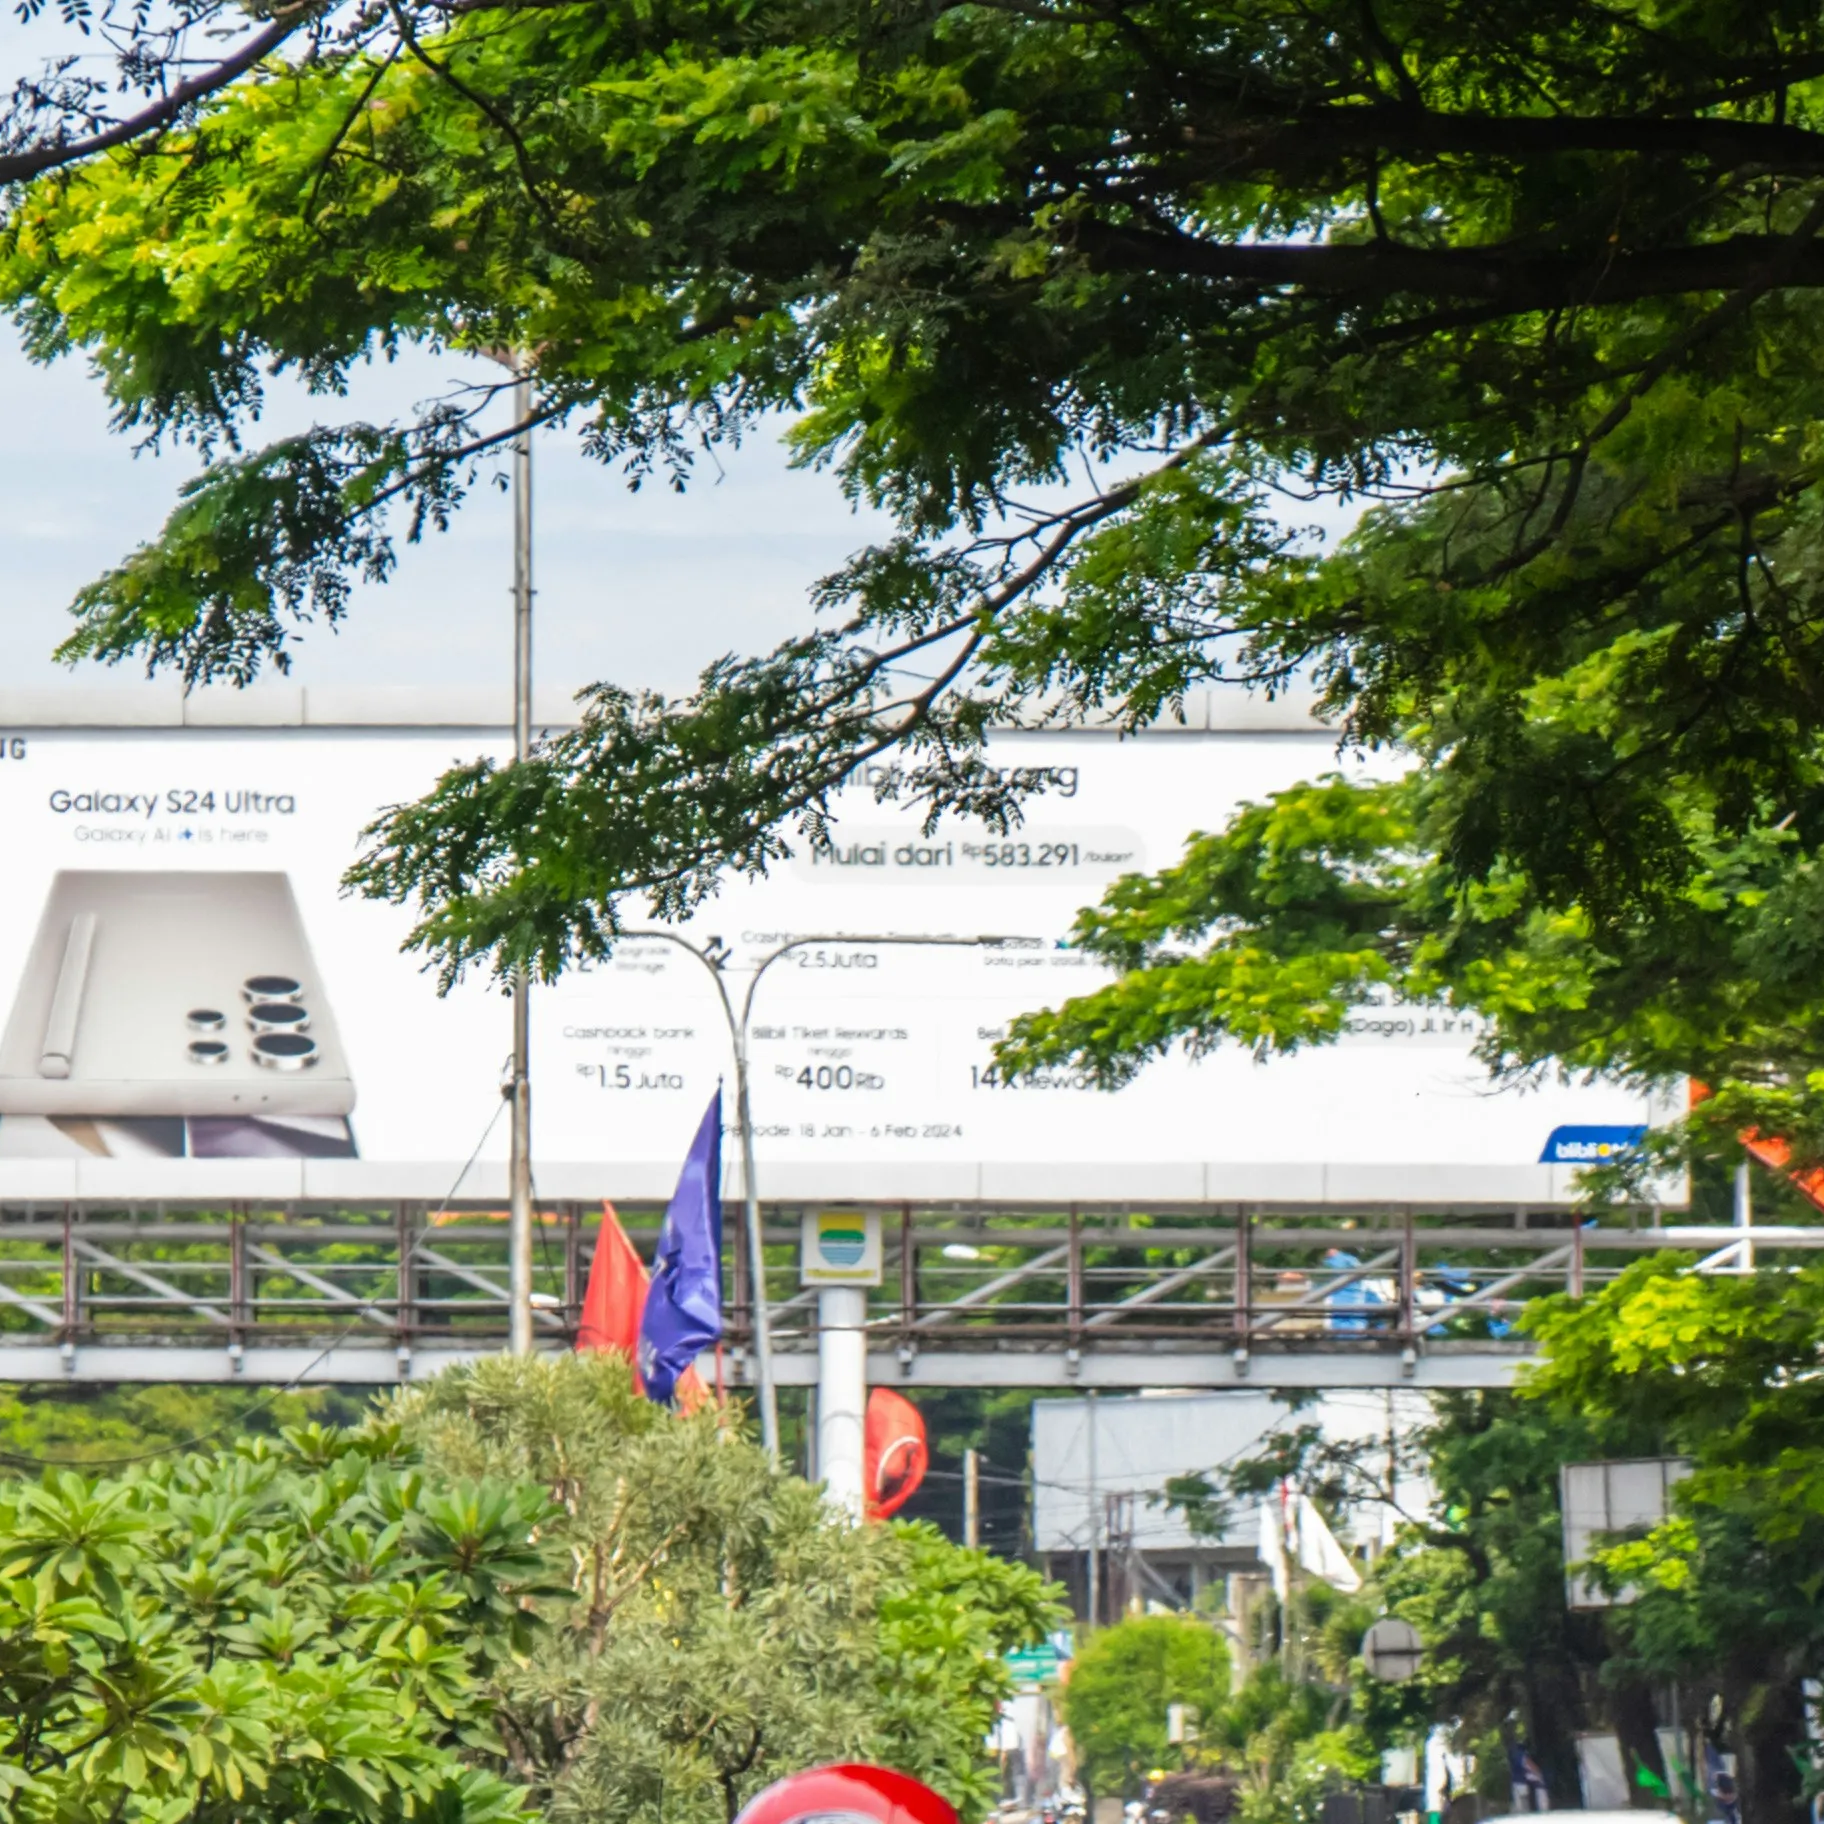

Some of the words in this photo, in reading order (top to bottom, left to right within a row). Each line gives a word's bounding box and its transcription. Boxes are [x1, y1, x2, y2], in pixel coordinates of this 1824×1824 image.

[48, 790, 158, 819] Galaxy
[166, 790, 216, 814] S24
[224, 789, 296, 814] Ultra
[73, 825, 146, 846] Galaxy
[220, 826, 269, 842] here
[811, 842, 886, 867] Mulai
[894, 842, 953, 867] dari
[563, 1026, 647, 1040] Cashback
[654, 1026, 695, 1040] bank
[833, 1026, 909, 1041] Rewards
[636, 1071, 684, 1090] Juta
[799, 1123, 815, 1138] 18
[820, 1123, 853, 1138] Jan
[884, 1123, 918, 1138] Feb
[922, 1123, 963, 1138] 2024
